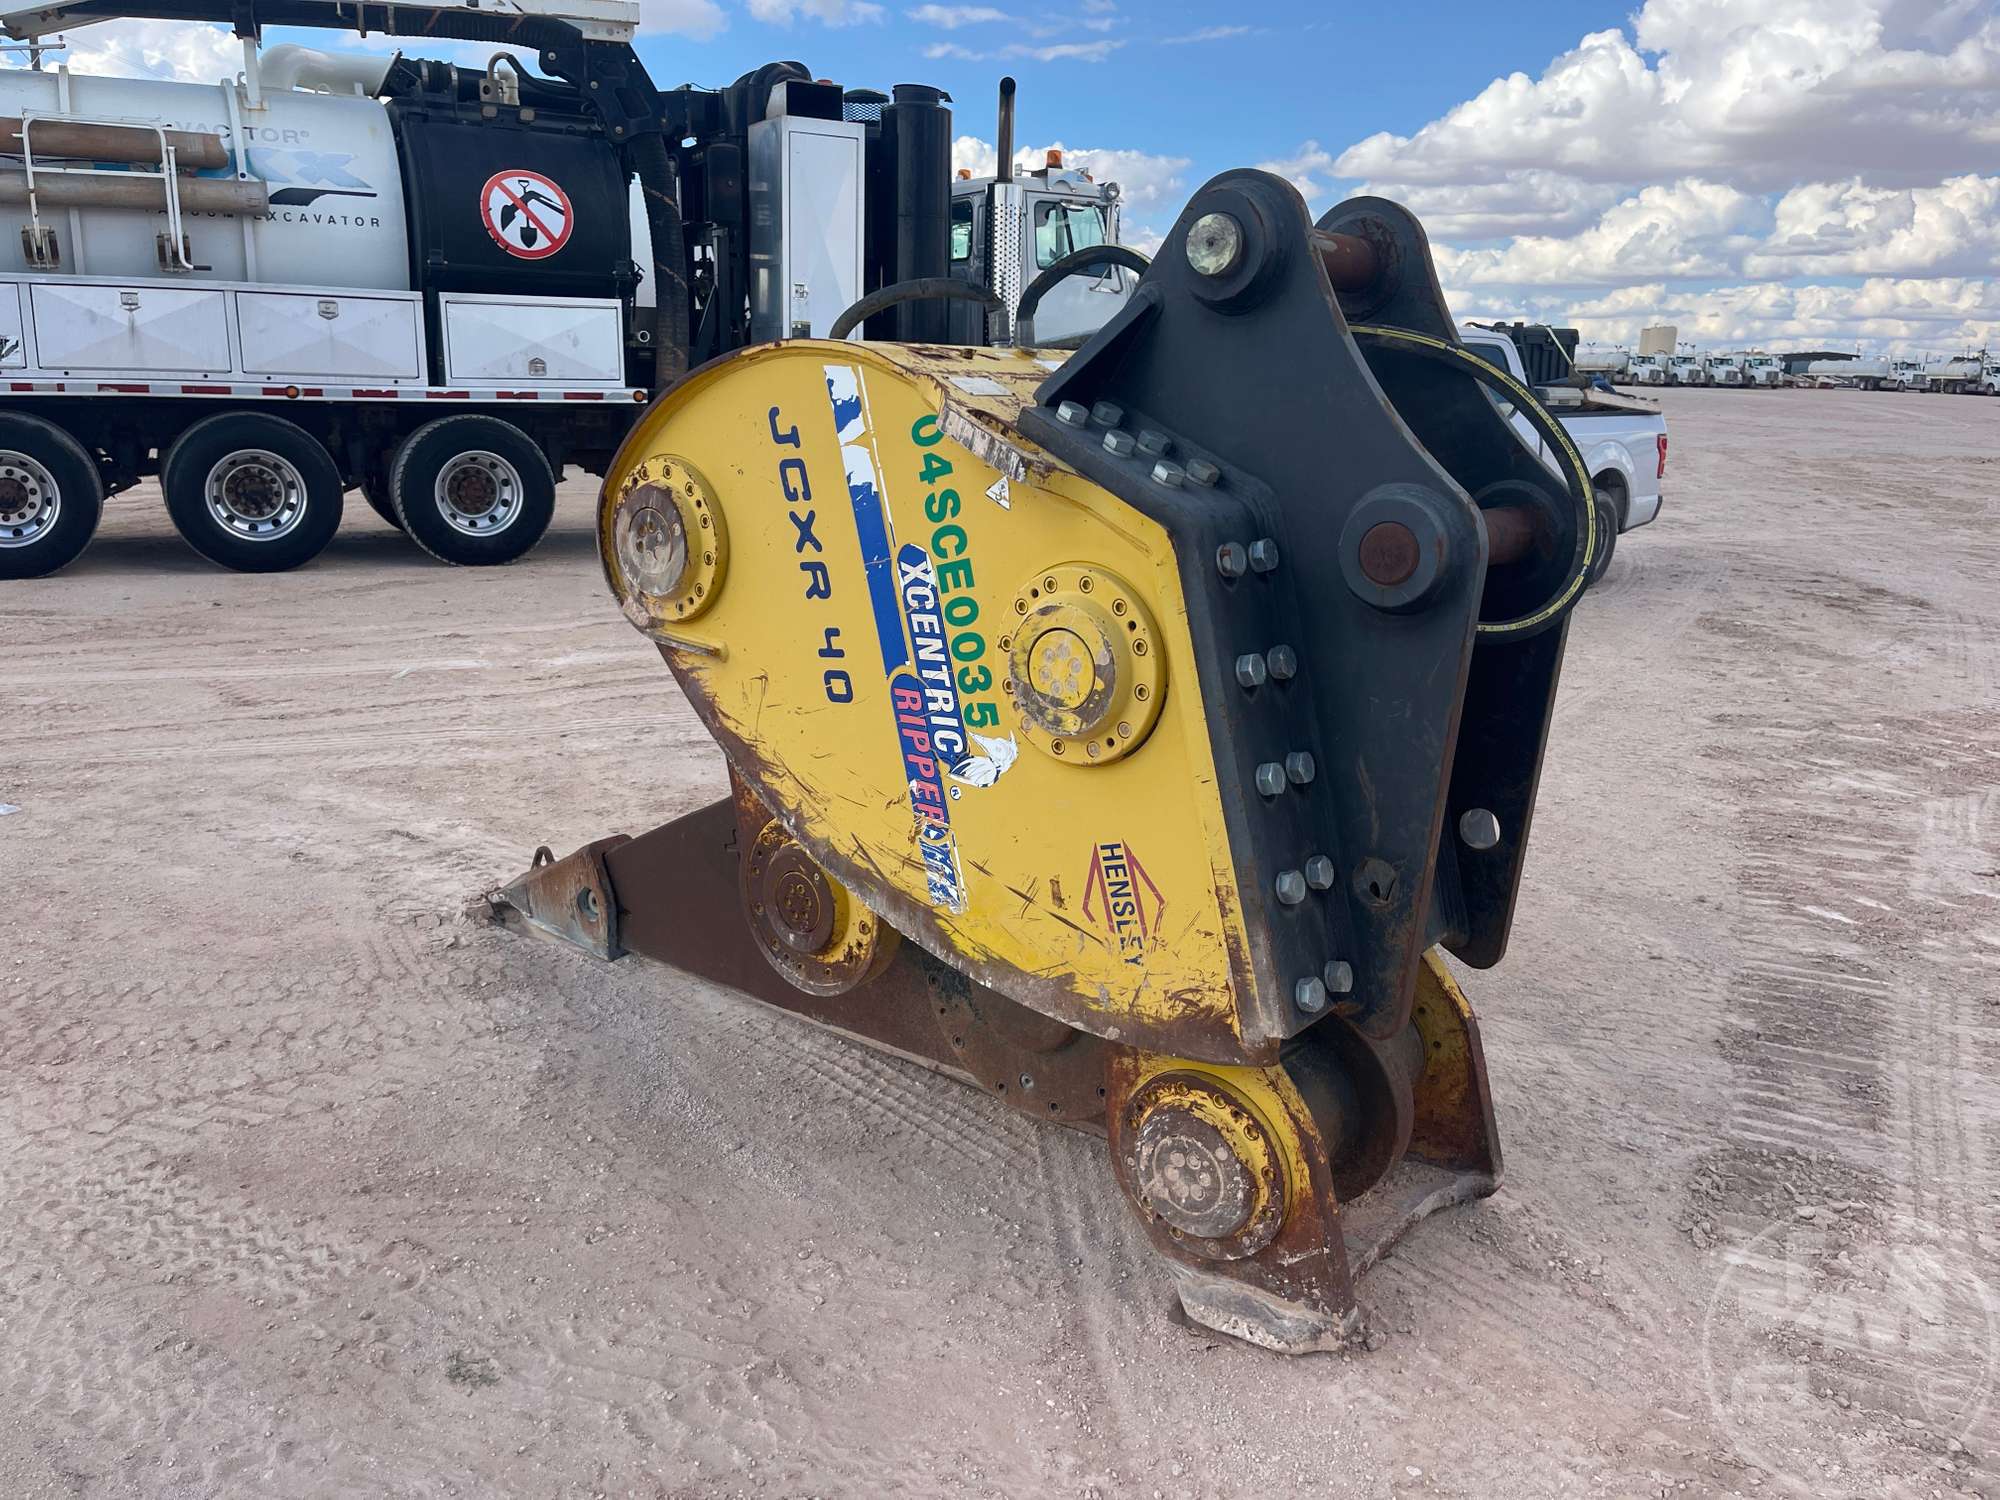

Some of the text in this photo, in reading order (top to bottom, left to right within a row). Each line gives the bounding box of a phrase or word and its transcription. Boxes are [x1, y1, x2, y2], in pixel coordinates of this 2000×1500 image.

[769, 406, 853, 703] JGXR 40
[900, 560, 963, 753] XCENTRIC
[894, 687, 946, 831] RIPPER
[1100, 843, 1144, 967] HENSLEY
